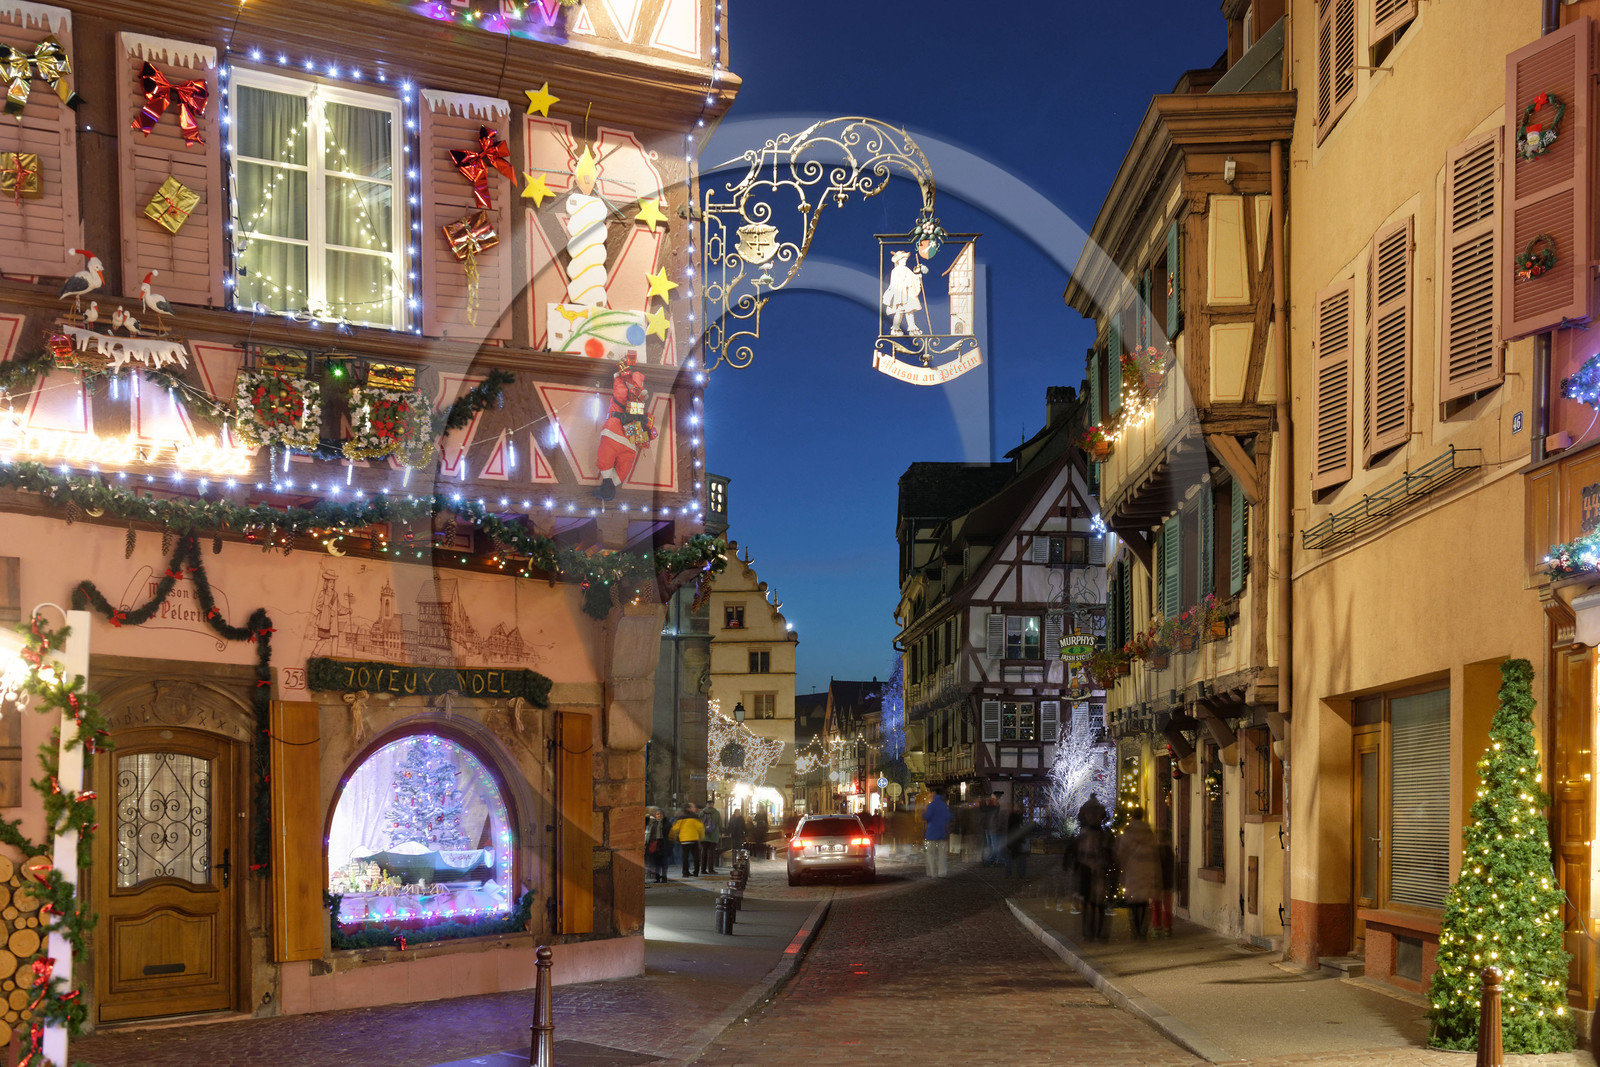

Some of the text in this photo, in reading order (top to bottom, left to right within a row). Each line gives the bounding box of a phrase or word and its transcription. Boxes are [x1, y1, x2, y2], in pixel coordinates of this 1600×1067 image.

[881, 358, 919, 380] Maison
[922, 373, 935, 382] au
[1513, 415, 1521, 430] 46
[457, 671, 511, 693] NOEL
